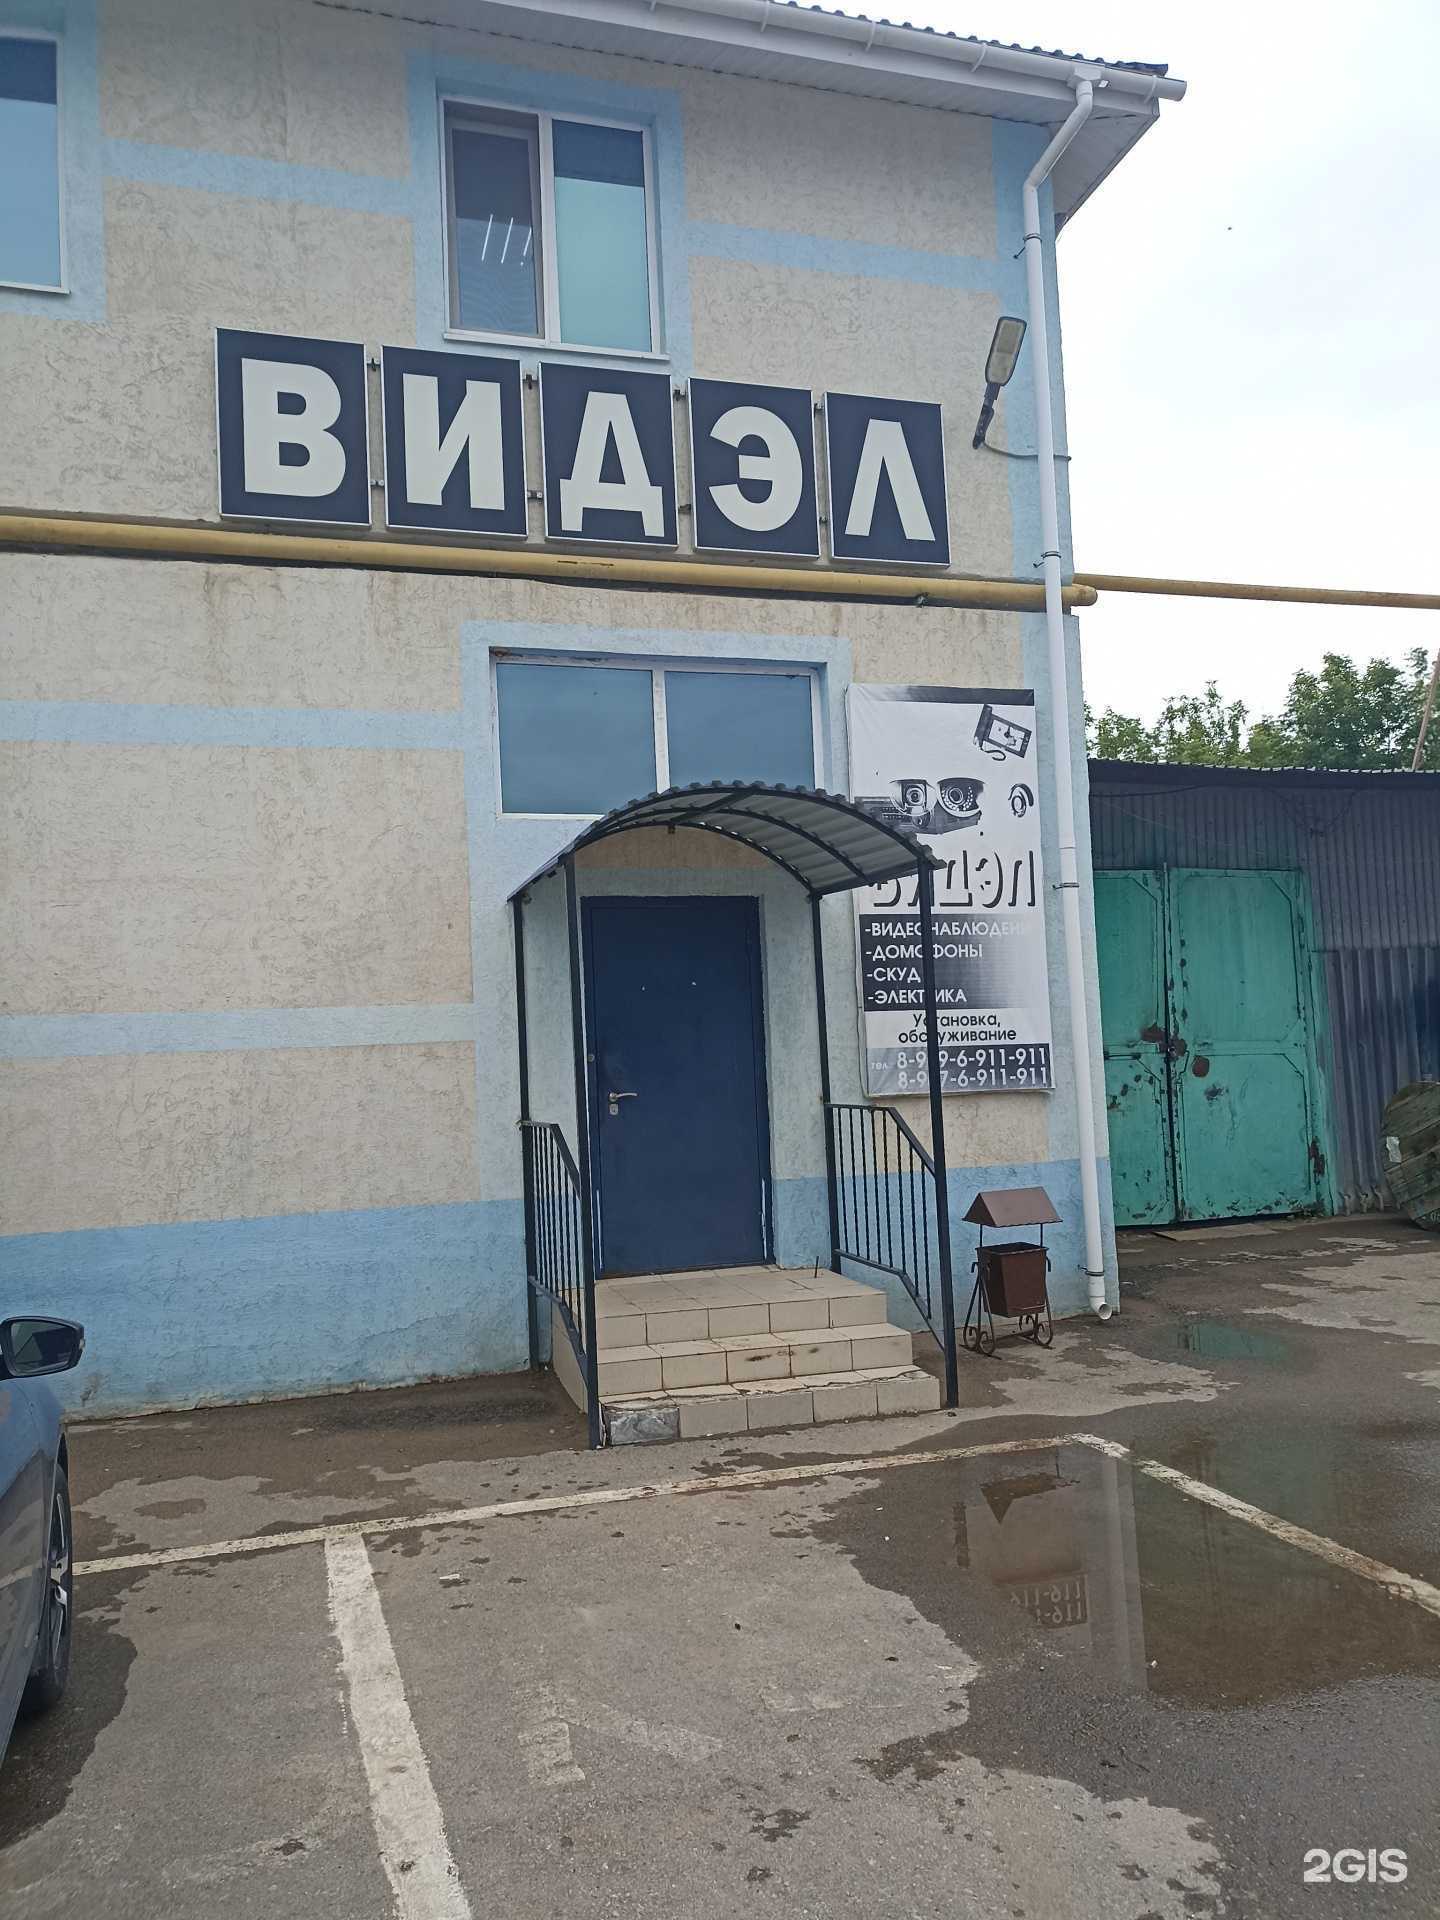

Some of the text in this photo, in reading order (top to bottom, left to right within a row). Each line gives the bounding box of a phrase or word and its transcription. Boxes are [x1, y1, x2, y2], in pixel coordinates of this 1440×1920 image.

[241, 357, 936, 542] ВИДЭЛ
[866, 967, 921, 983] -СКУД
[867, 988, 968, 1005] -ЭЛЕКТИКА
[912, 1011, 1001, 1028] Уановка,
[898, 1028, 1017, 1045] обсуживание
[896, 1047, 1047, 1070] 8-99-6-911-911
[898, 1066, 1048, 1089] 8-97-6-911-911
